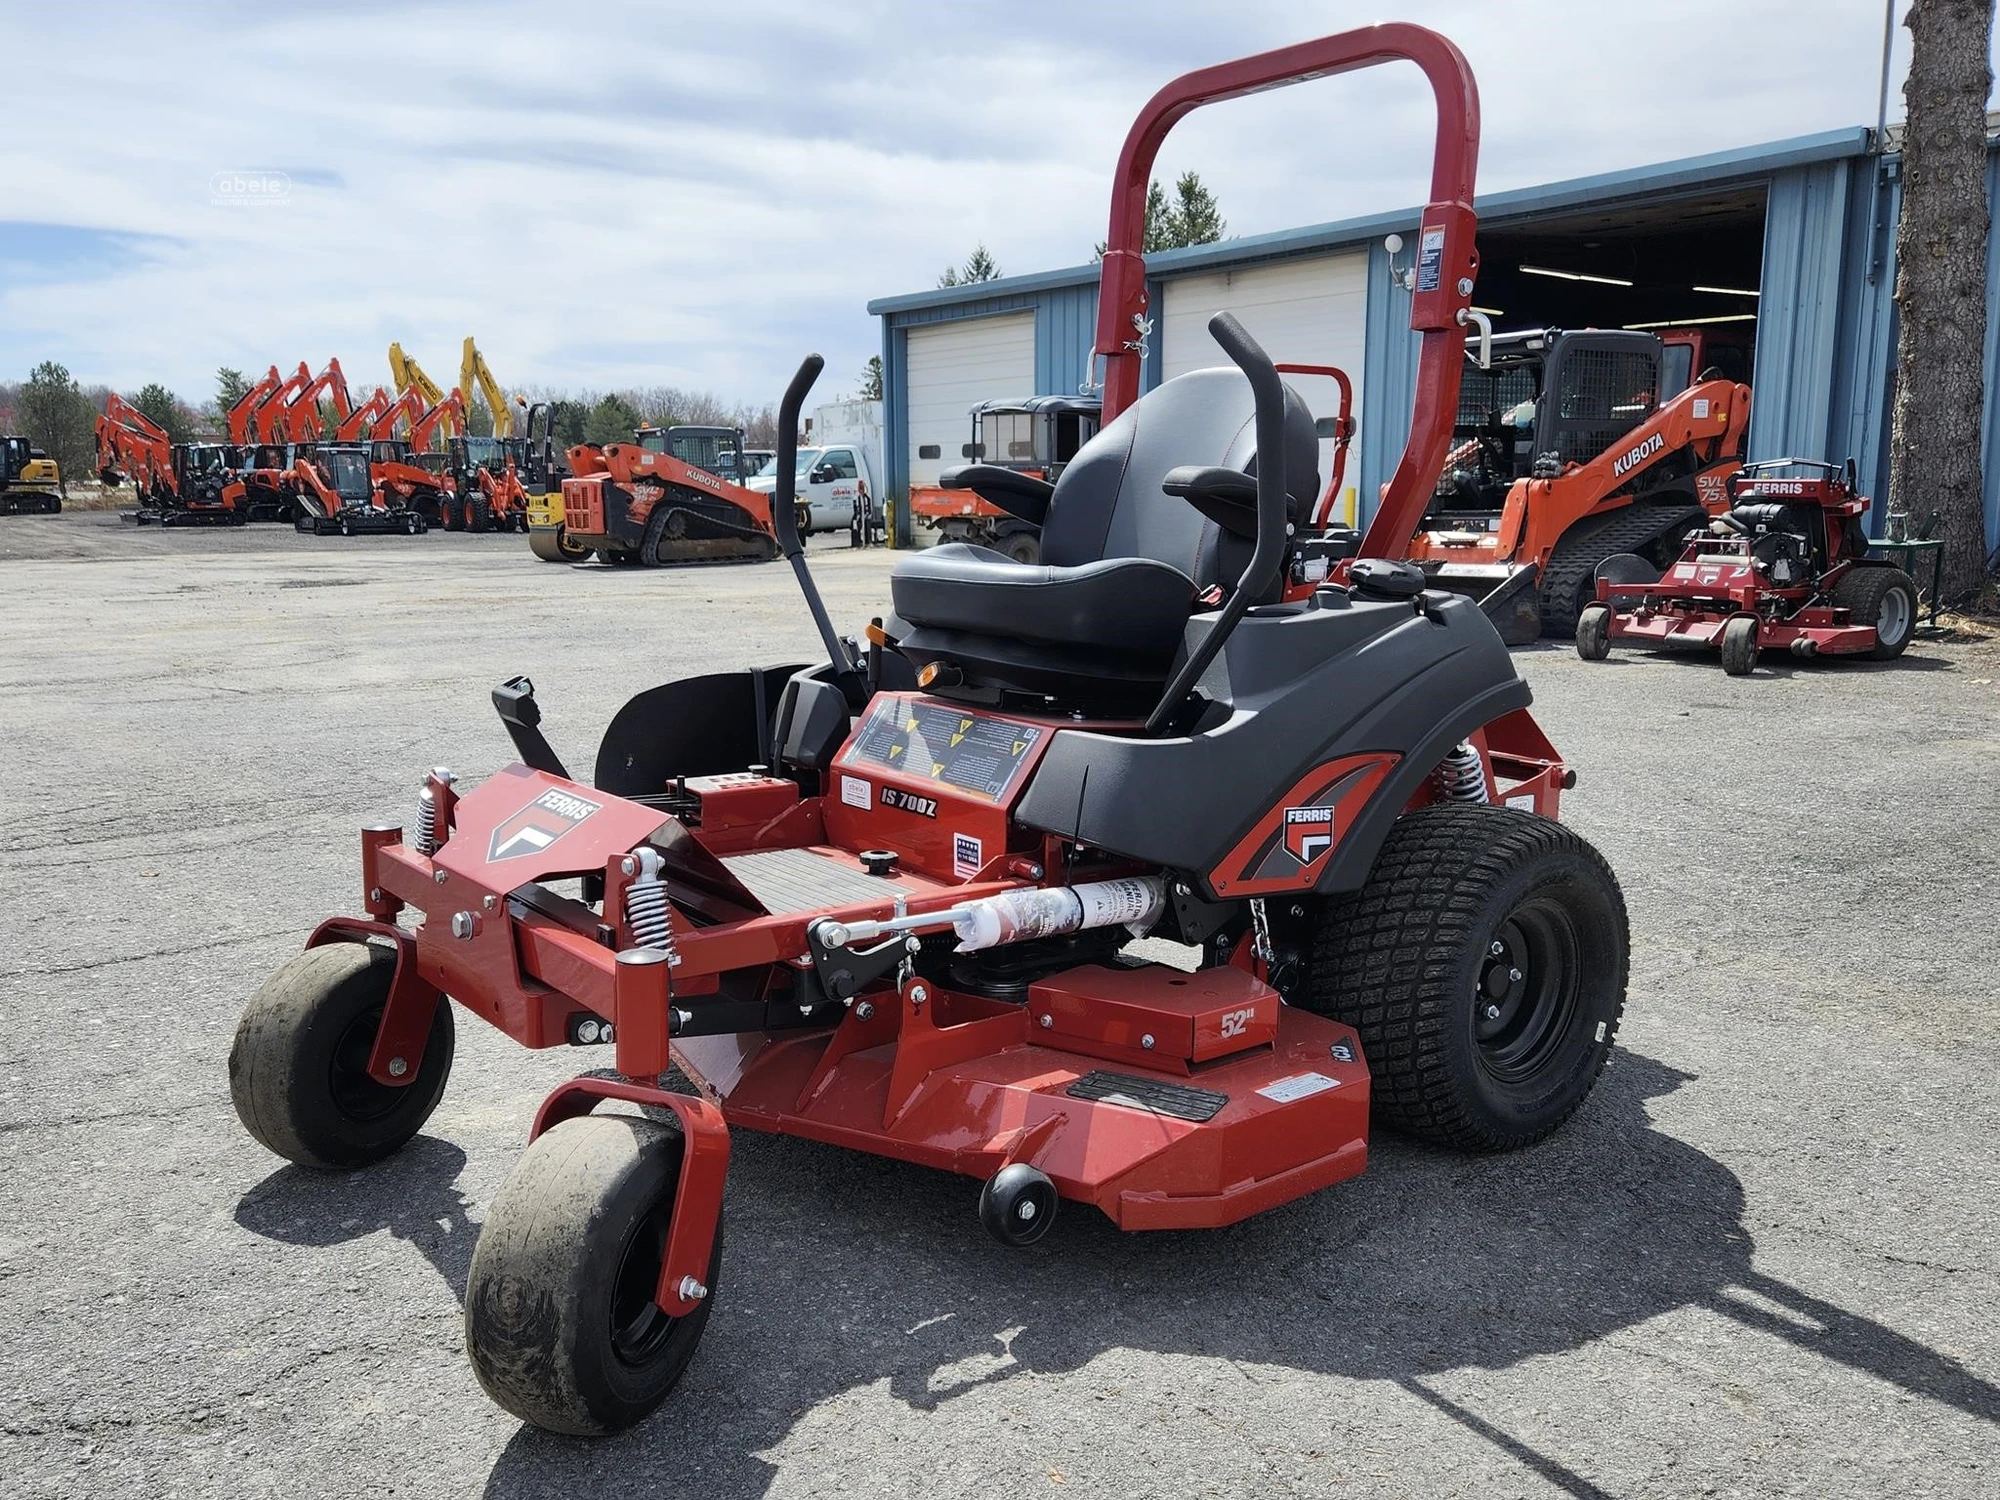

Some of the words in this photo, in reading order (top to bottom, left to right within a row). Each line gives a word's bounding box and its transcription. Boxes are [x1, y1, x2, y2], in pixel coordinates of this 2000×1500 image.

[1613, 432, 1665, 477] KUBOTA
[686, 469, 720, 490] KUBOTA
[1698, 476, 1726, 488] SVL
[1753, 483, 1803, 495] FERRIS
[537, 792, 595, 820] FERRIS
[881, 788, 897, 805] IS
[899, 793, 937, 817] 700Z
[1287, 810, 1332, 823] FERRIS
[1221, 1008, 1255, 1038] 52"
